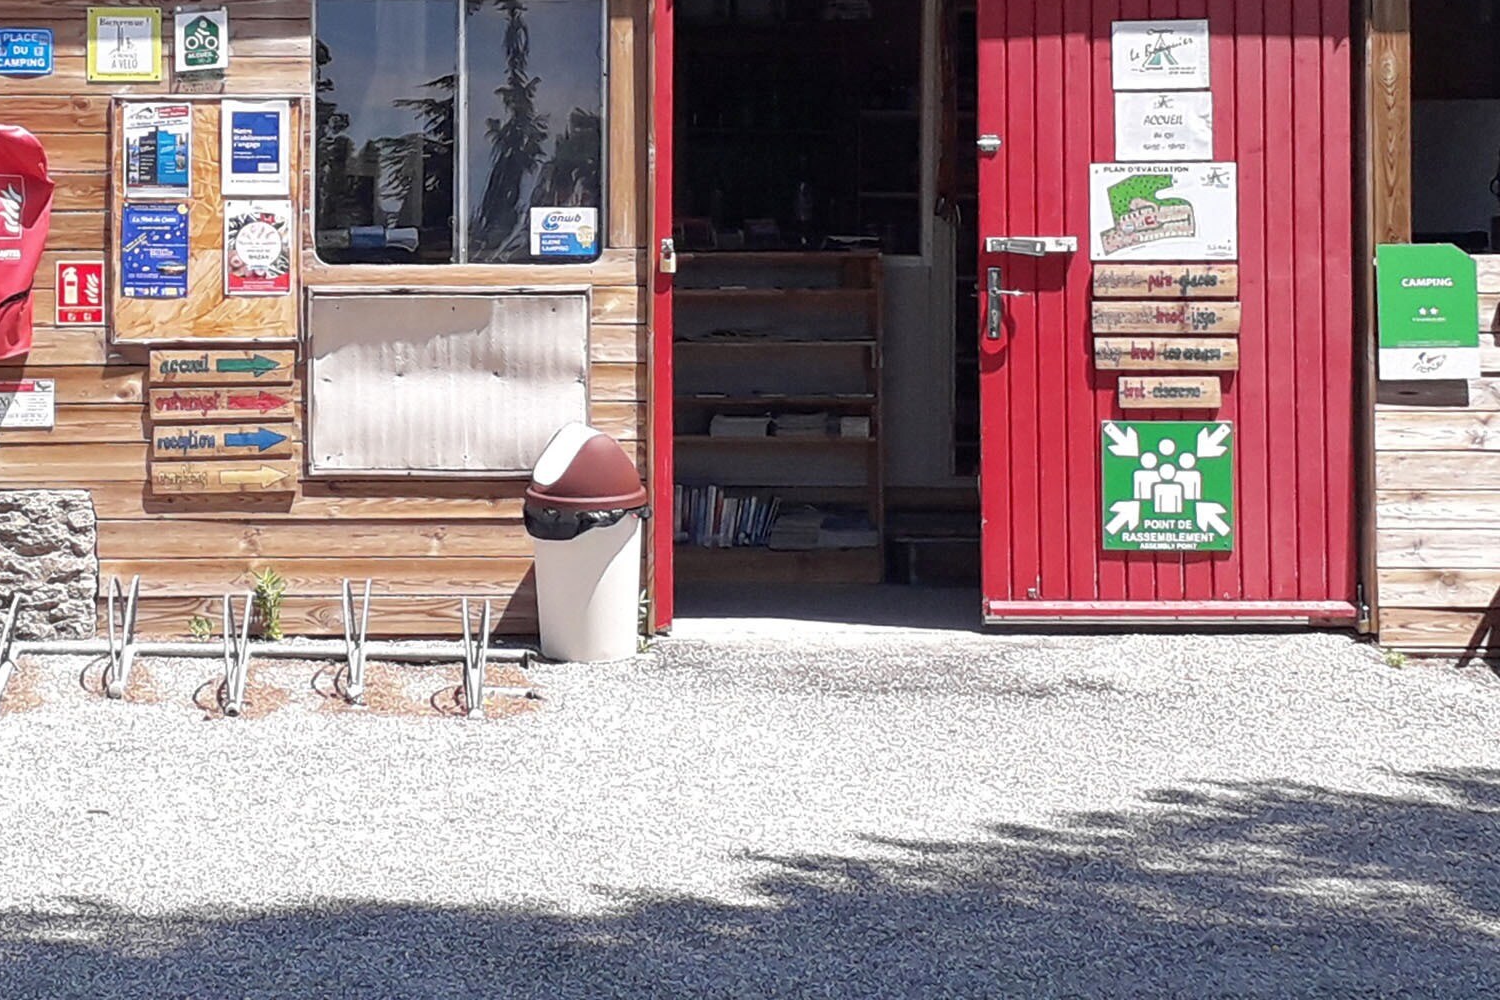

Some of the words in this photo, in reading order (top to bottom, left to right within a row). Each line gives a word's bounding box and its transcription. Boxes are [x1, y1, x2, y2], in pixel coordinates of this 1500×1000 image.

[3, 33, 38, 42] PLACE
[13, 45, 29, 55] DU
[1143, 114, 1184, 126] ACCUEIL
[1401, 278, 1454, 287] CAMPING
[159, 354, 210, 374] accueil
[1144, 519, 1176, 530] POINT
[1177, 519, 1192, 529] DE
[1122, 533, 1215, 542] RASSEMBLEMENT
